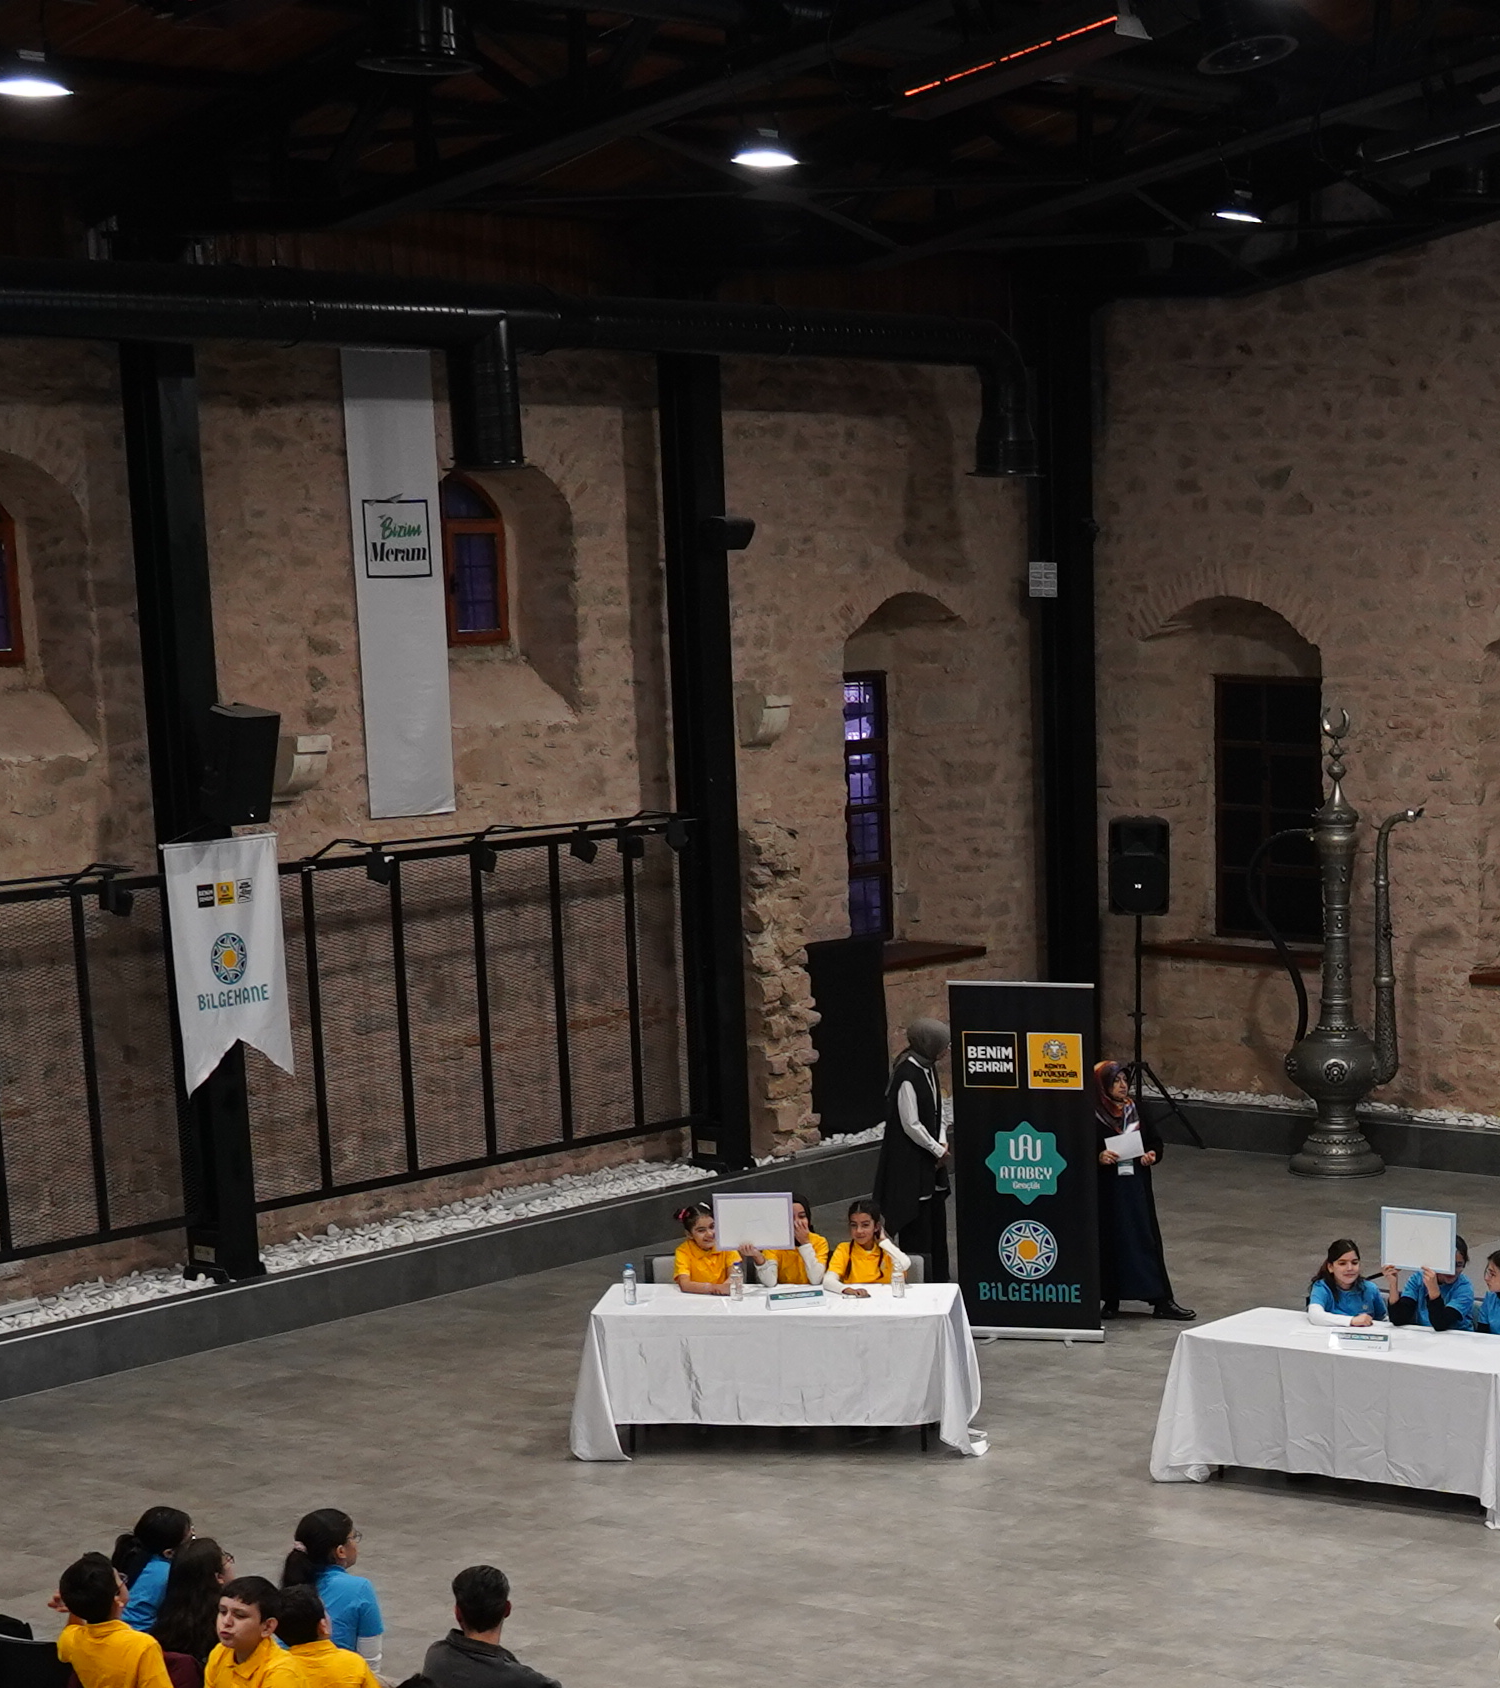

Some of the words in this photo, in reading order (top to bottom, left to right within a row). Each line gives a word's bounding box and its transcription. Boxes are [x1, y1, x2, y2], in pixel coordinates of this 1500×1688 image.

[380, 516, 422, 540] Bizim
[370, 542, 427, 562] Meram
[1000, 1165, 1053, 1180] ATABEY
